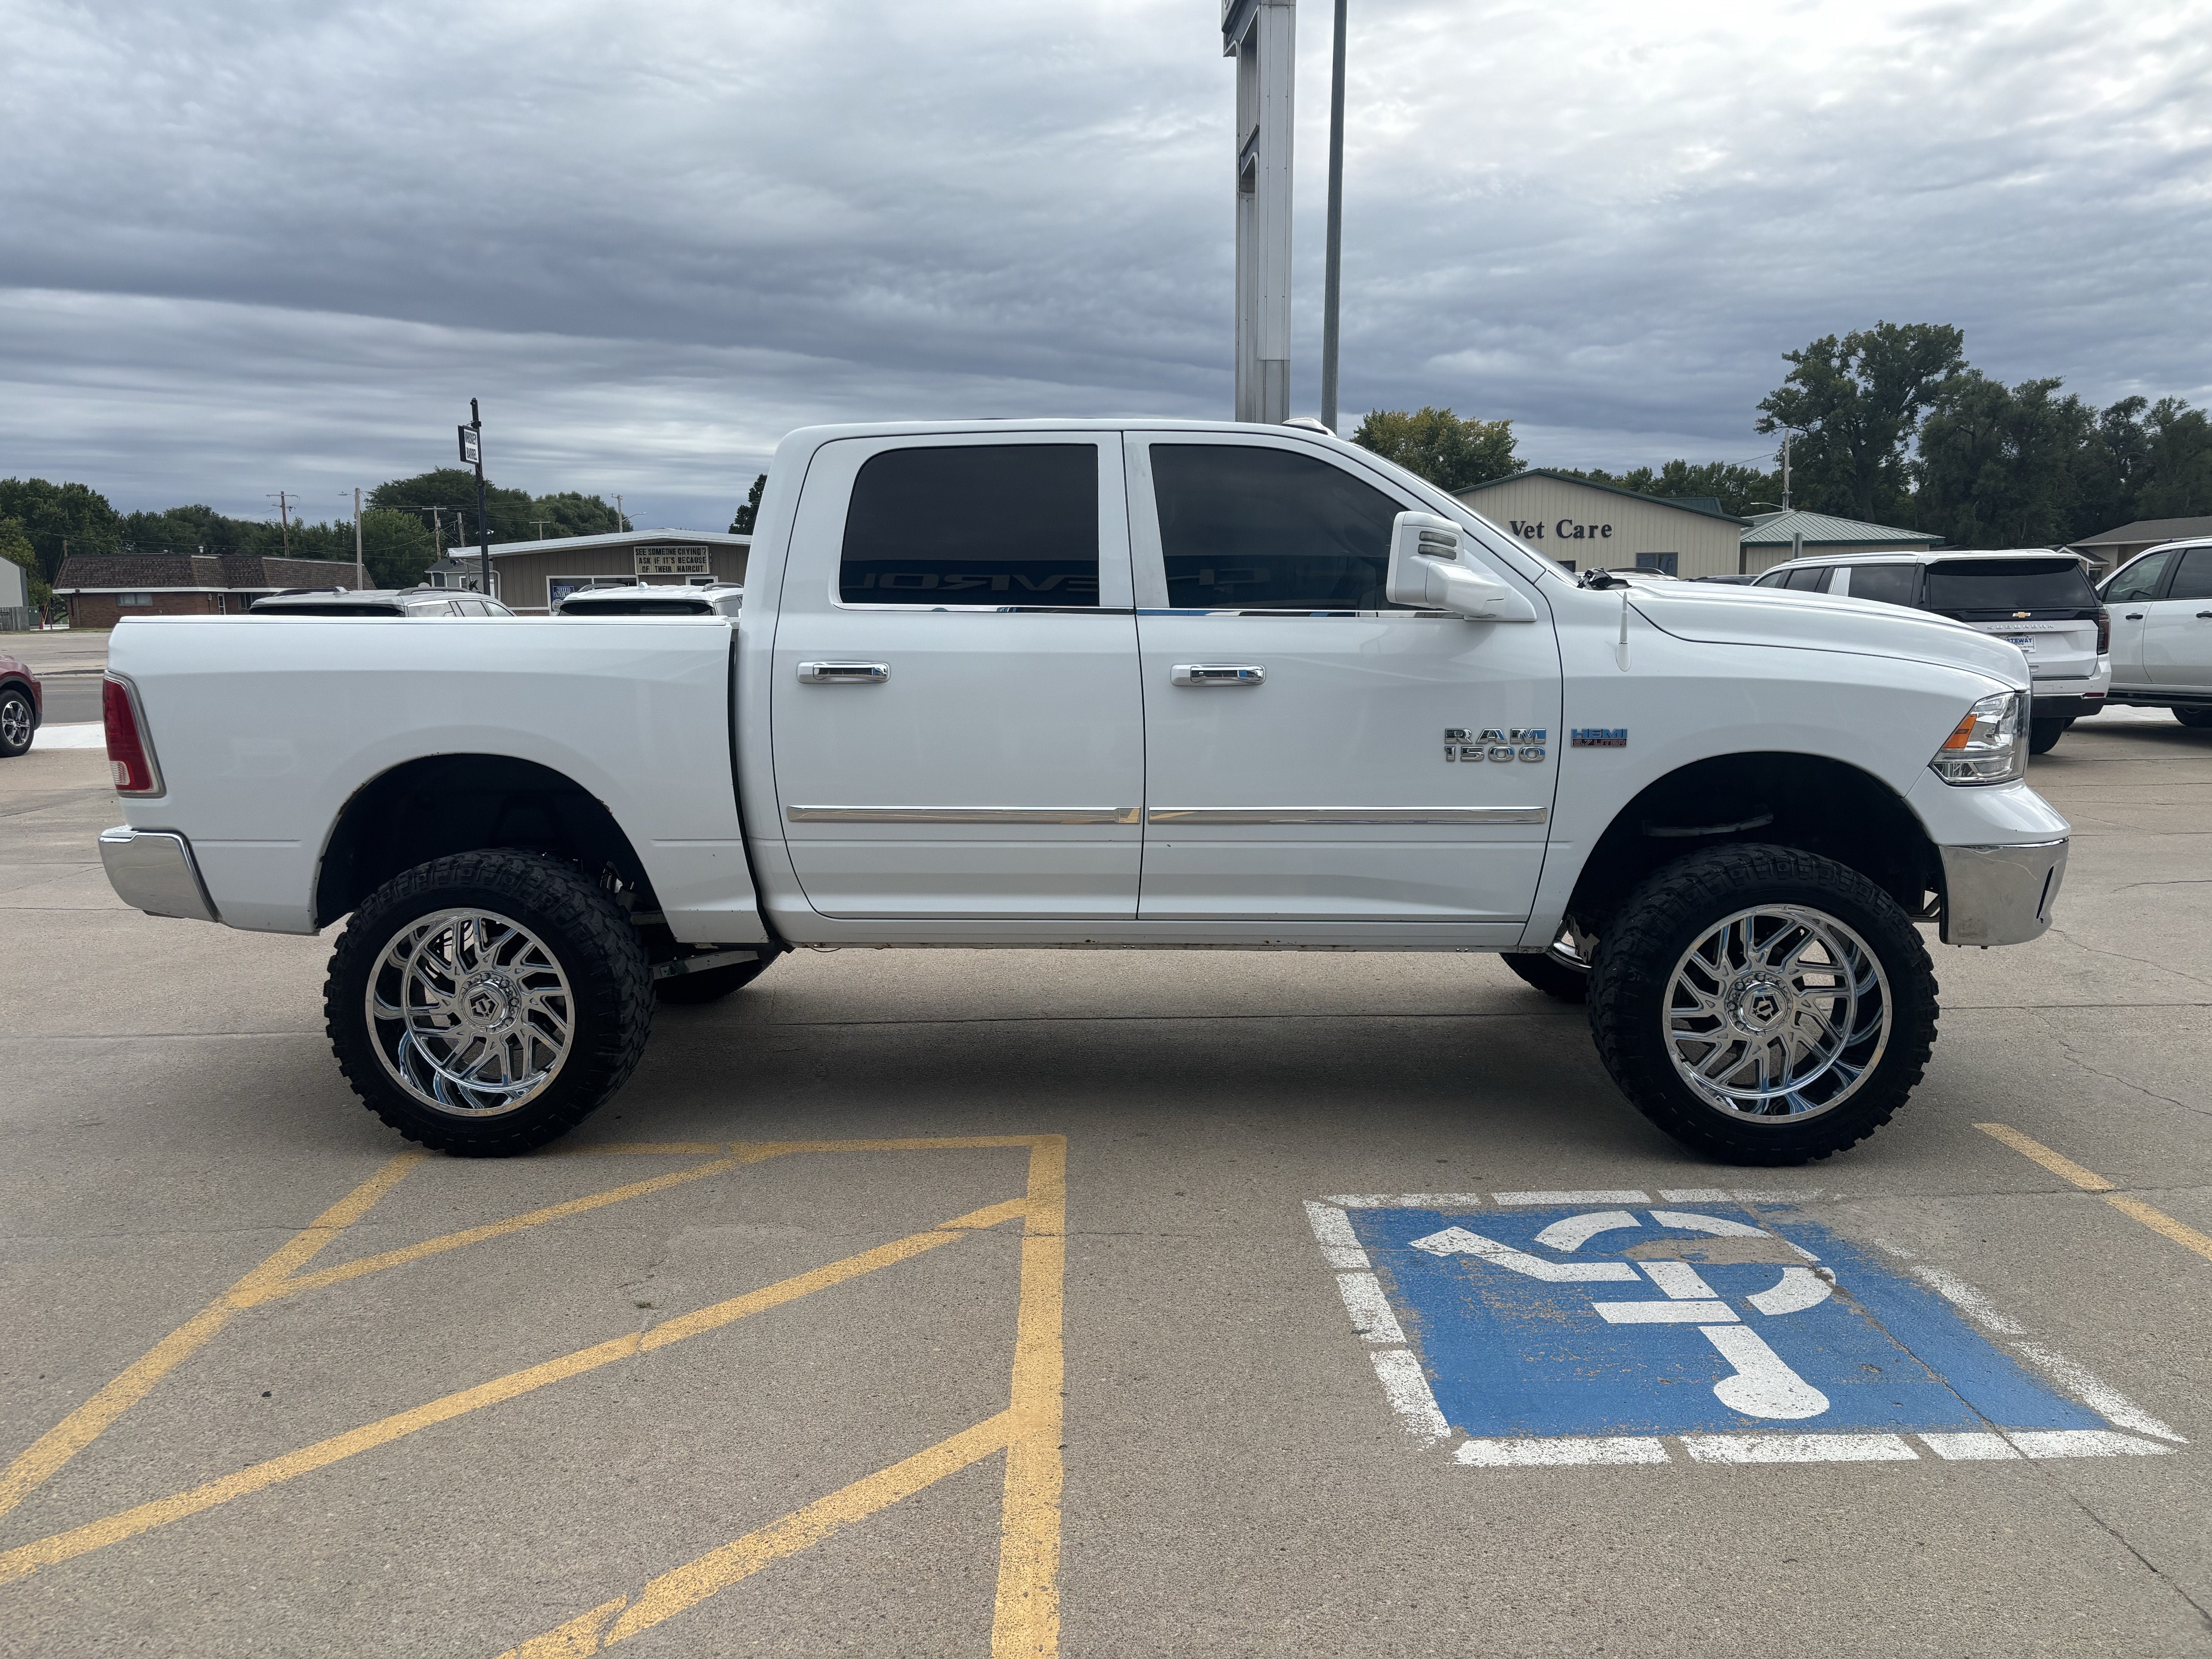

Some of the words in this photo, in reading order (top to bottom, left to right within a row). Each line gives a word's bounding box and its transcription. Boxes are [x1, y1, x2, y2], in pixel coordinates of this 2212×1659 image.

[1509, 520, 1545, 539] Vet
[1556, 519, 1612, 539] Care
[1444, 728, 1547, 744] RAM
[1571, 728, 1628, 739] HEMI
[1444, 746, 1546, 763] 1500
